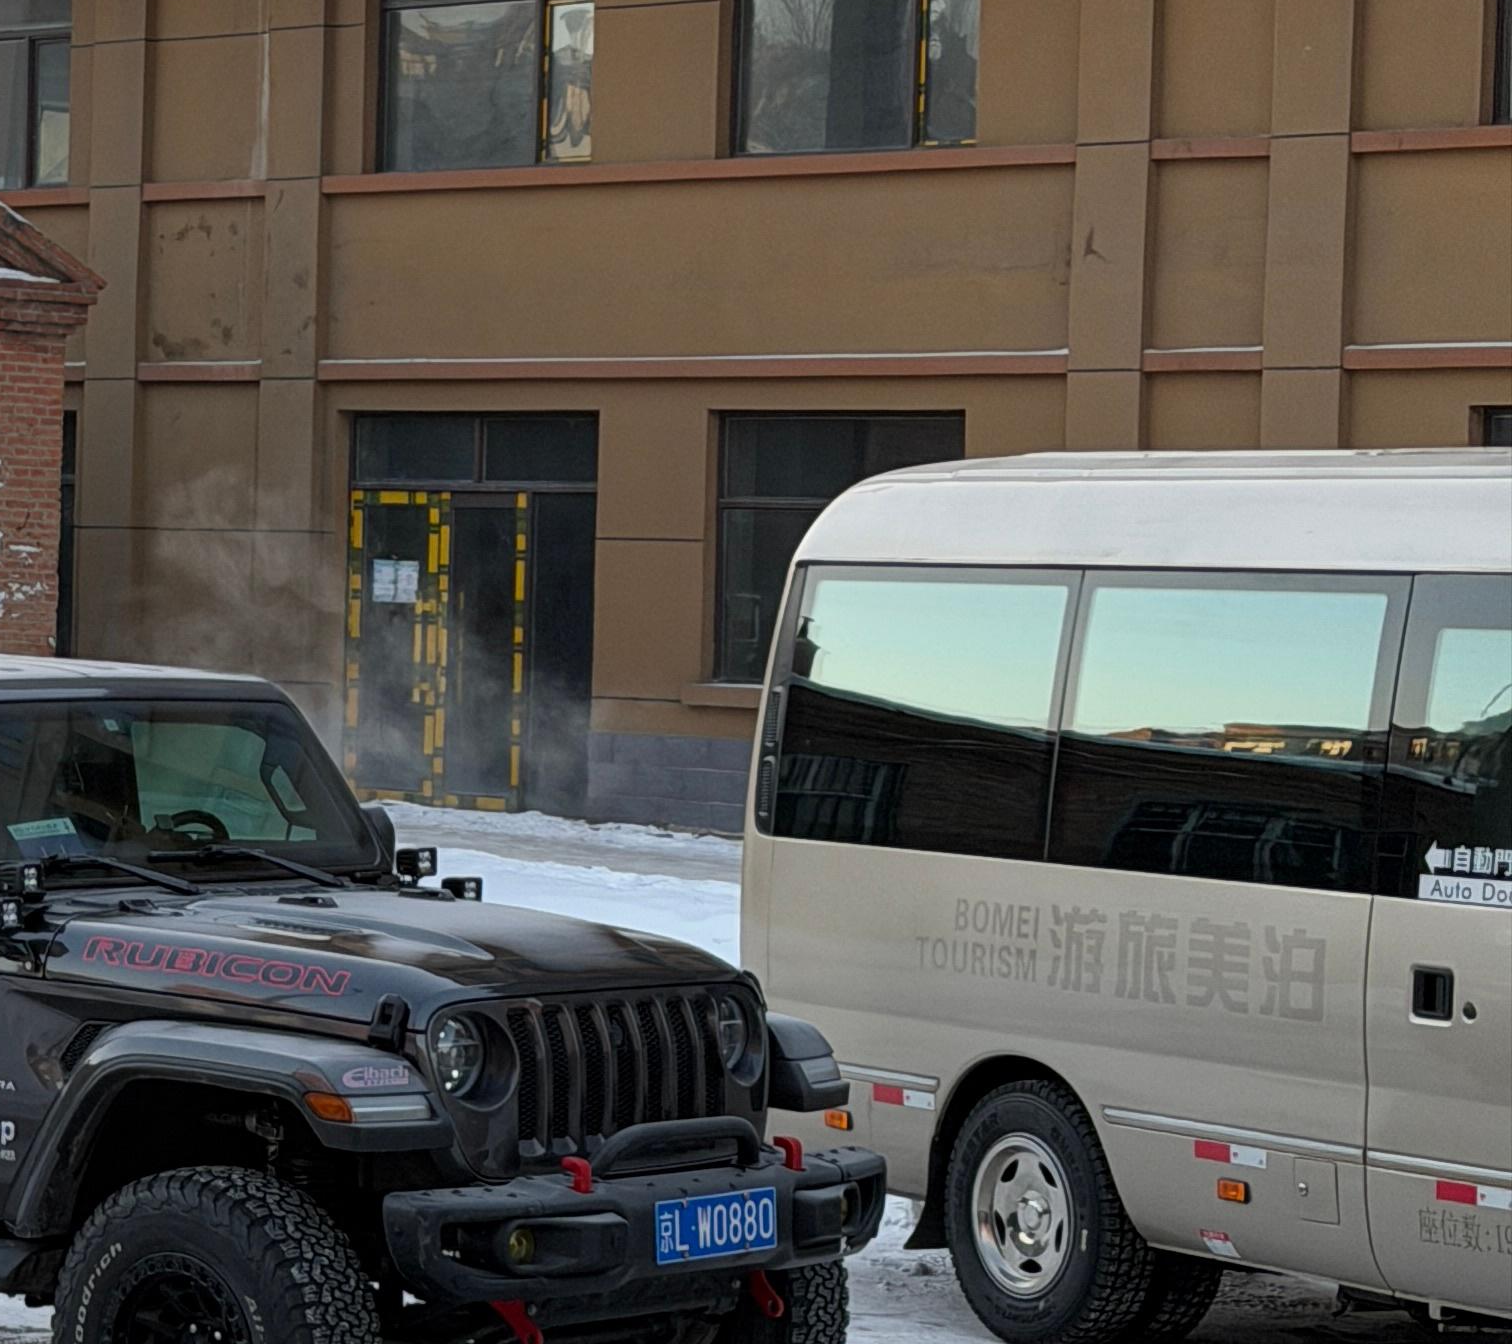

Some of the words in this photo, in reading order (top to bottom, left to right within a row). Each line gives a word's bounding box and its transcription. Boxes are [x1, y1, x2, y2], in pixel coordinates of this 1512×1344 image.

[1430, 879, 1472, 900] Auto
[954, 898, 1040, 941] BOMEI
[83, 935, 352, 996] RUBICON
[916, 936, 1037, 983] TOURISM
